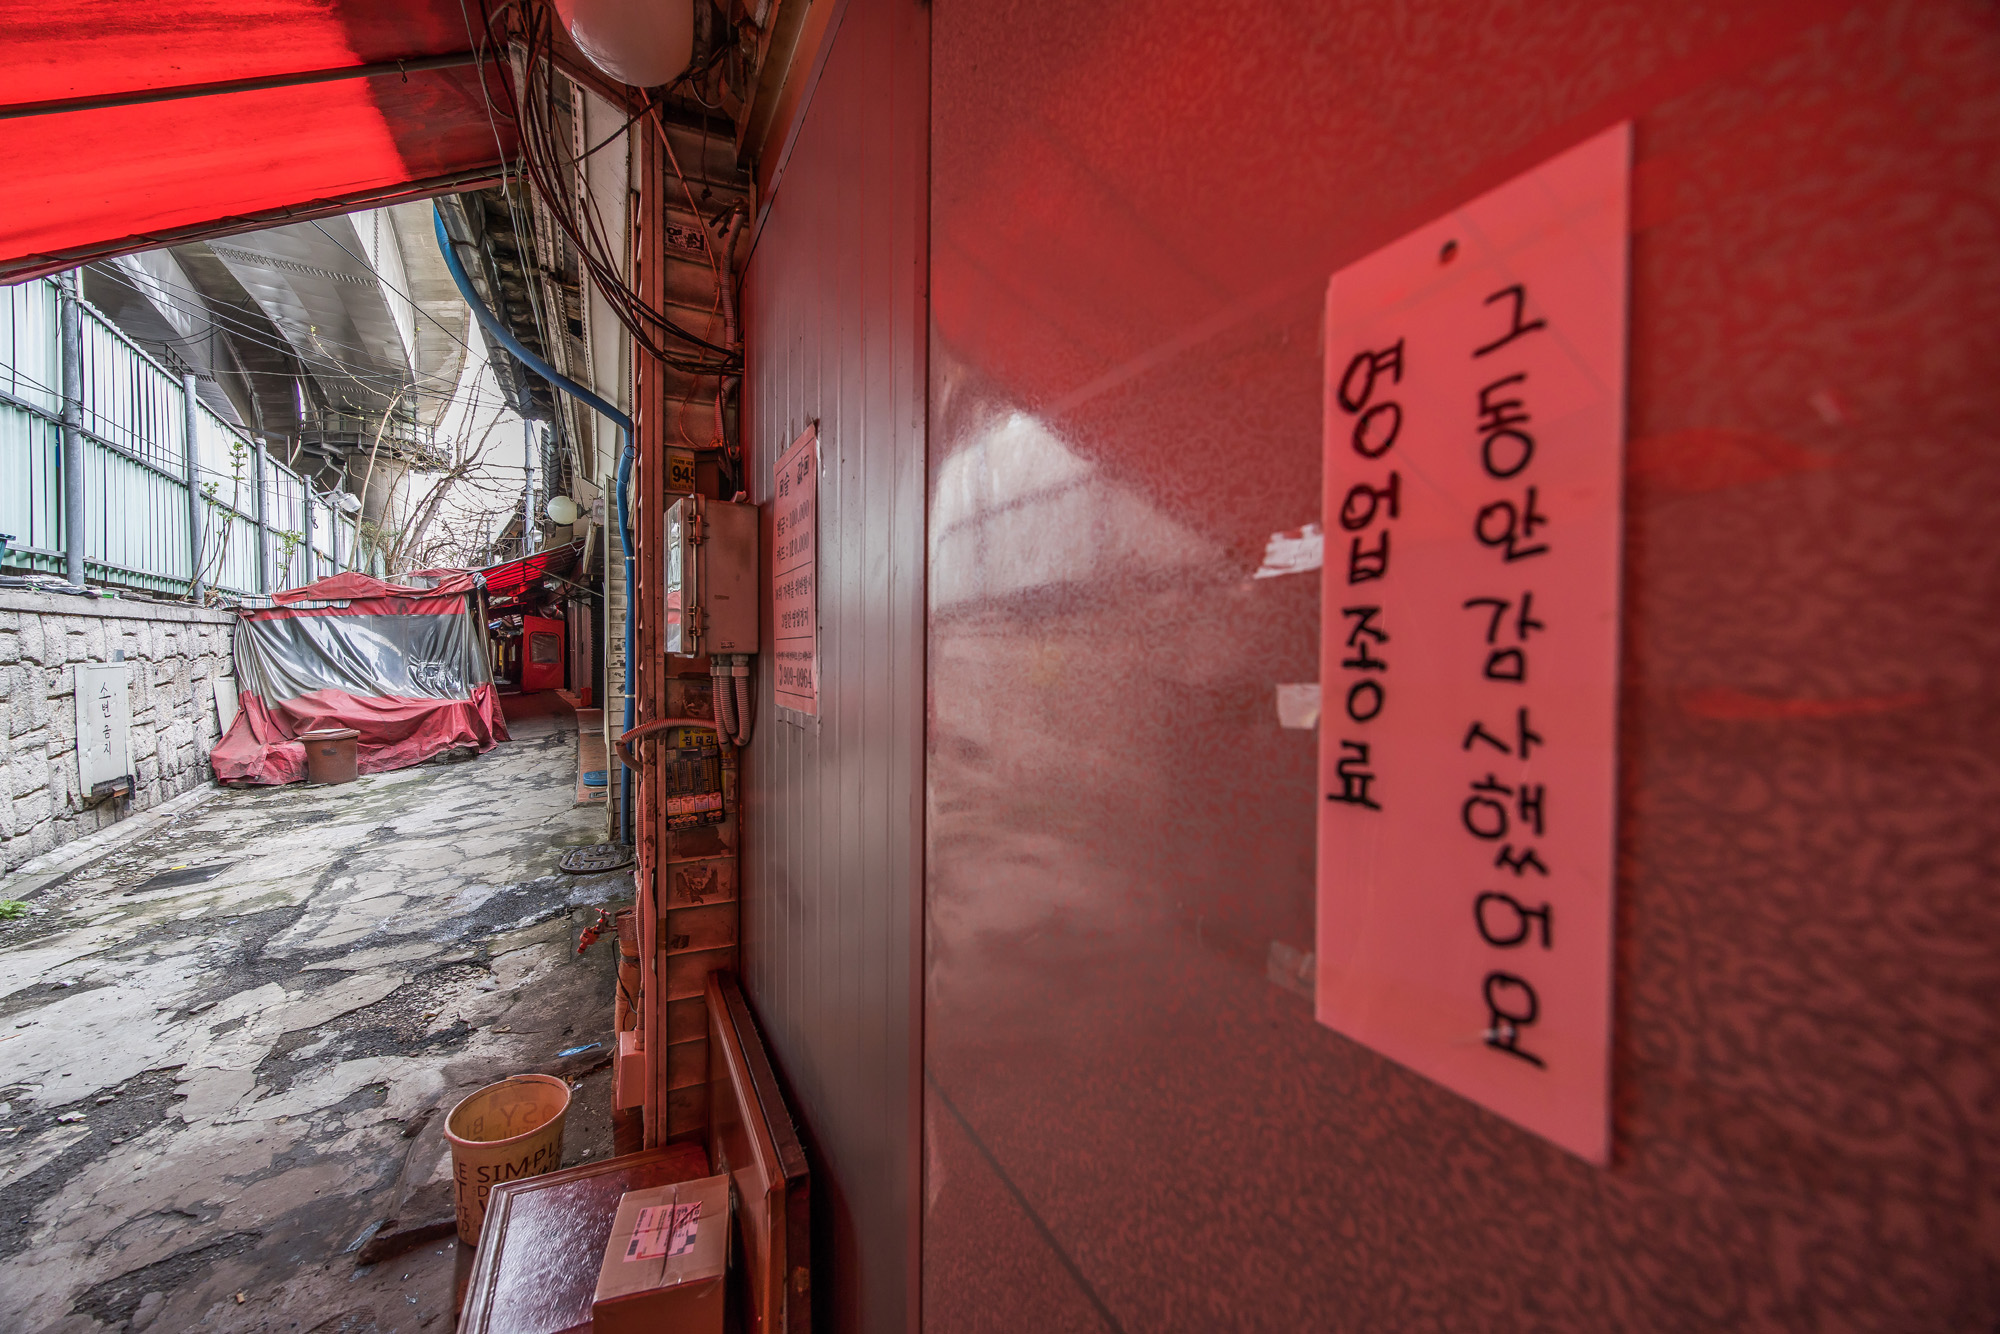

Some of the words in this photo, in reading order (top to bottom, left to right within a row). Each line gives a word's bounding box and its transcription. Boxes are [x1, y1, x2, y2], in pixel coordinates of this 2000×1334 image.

[1471, 284, 1550, 564] 그동안
[98, 681, 112, 719] 소변
[1326, 336, 1406, 813] 영업종료
[102, 723, 112, 757] 금지
[1462, 590, 1552, 1071] 감사했어요
